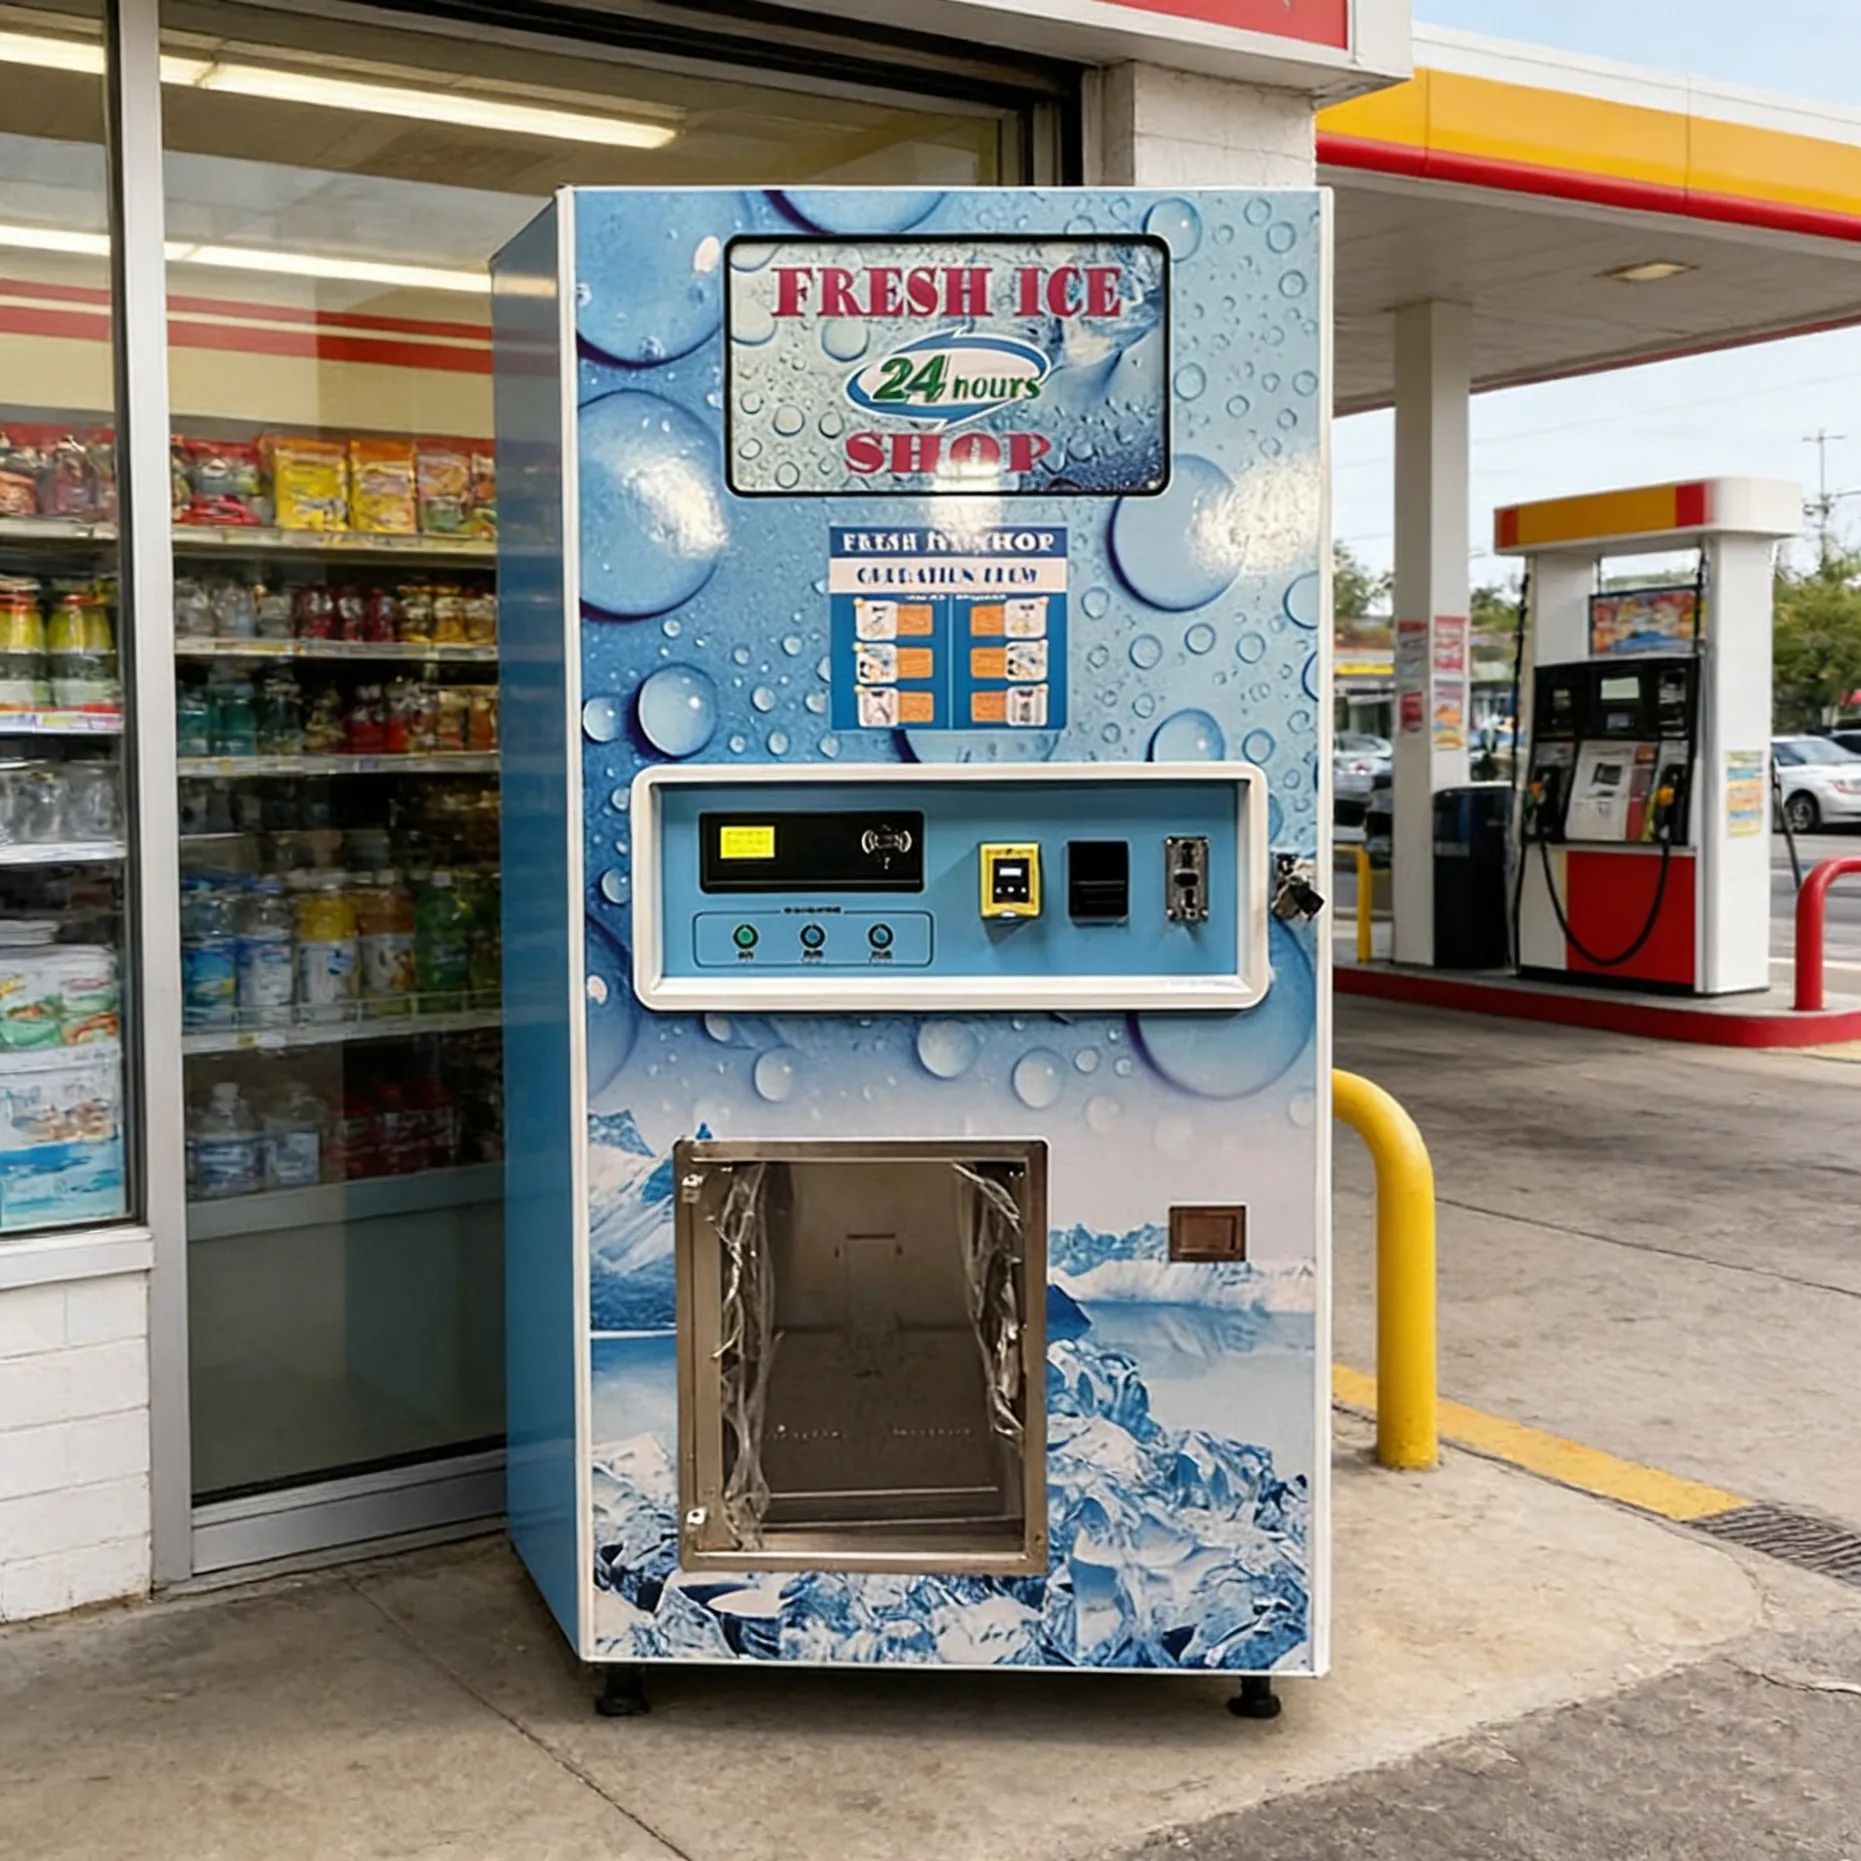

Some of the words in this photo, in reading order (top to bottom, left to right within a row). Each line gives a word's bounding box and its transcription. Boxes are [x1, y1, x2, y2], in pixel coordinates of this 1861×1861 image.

[771, 266, 992, 318] FRESH
[1015, 266, 1122, 318] ICE
[872, 354, 950, 403] 24
[952, 374, 1041, 400] hours
[844, 431, 1051, 474] SHOP
[842, 533, 917, 552] FRESH
